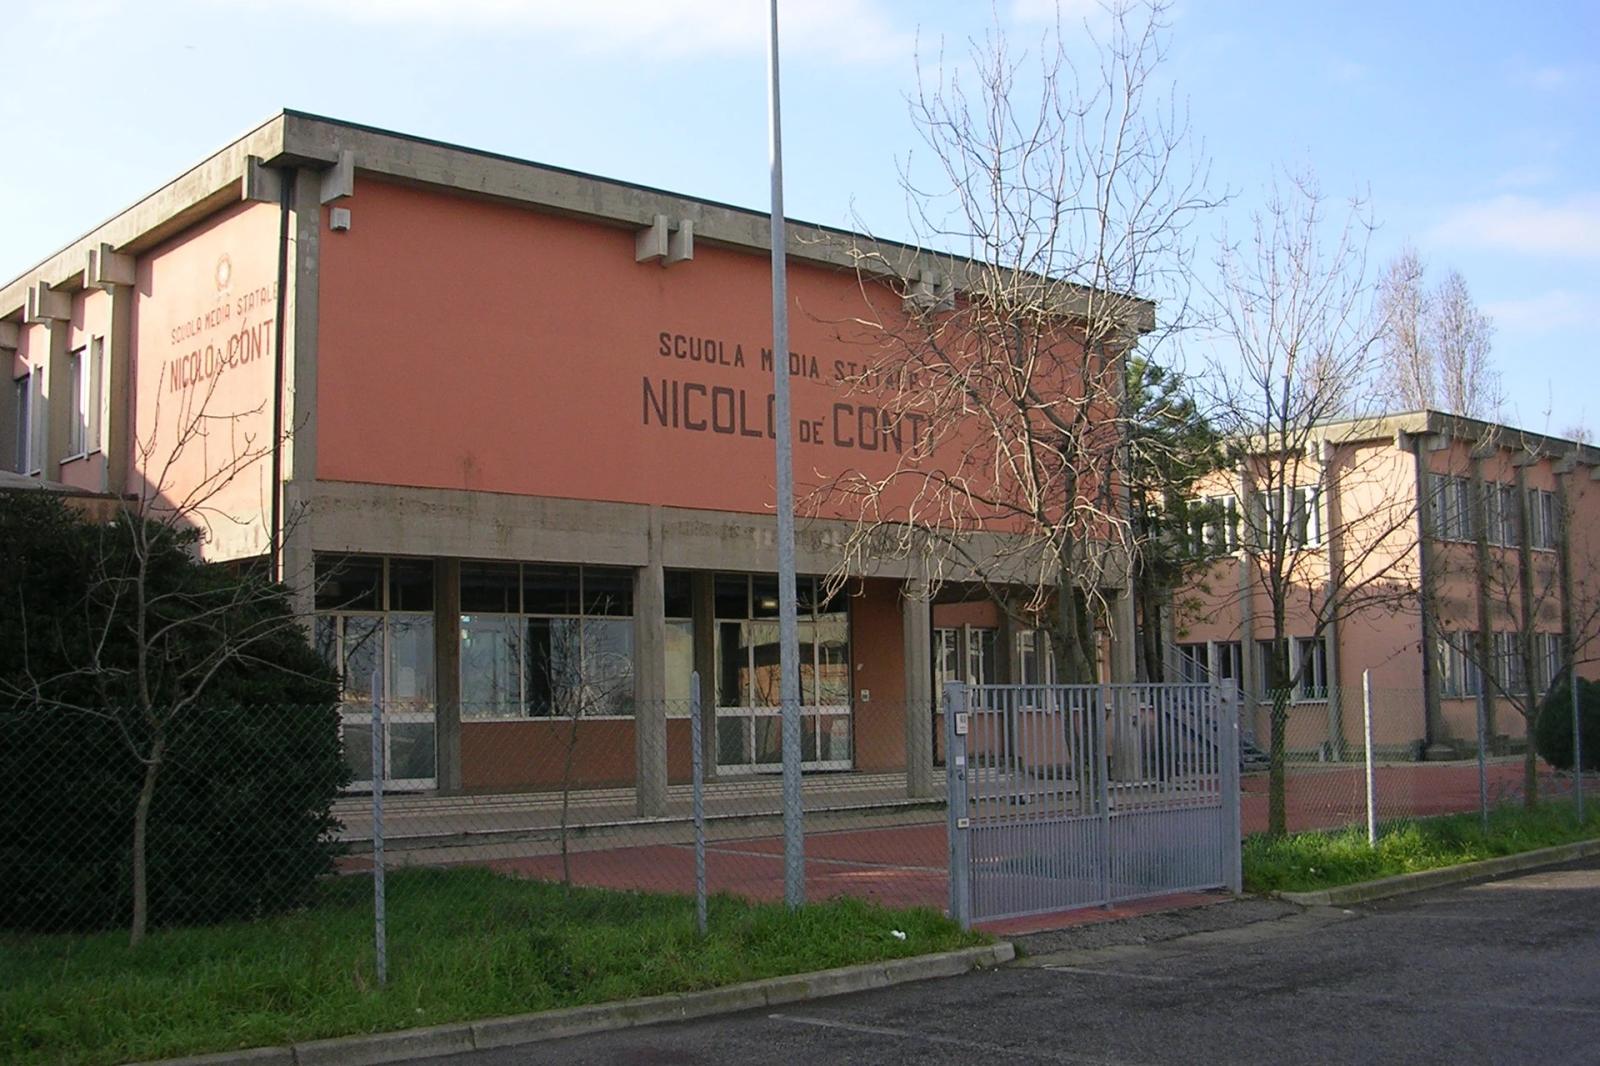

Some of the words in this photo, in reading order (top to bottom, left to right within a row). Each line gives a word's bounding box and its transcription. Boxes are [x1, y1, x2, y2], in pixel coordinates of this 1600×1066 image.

[171, 316, 201, 345] SCUOLA
[205, 303, 230, 331] MEDIA
[659, 332, 745, 368] SCUOLA
[761, 348, 820, 379] MDIA
[833, 403, 934, 457] CONTI
